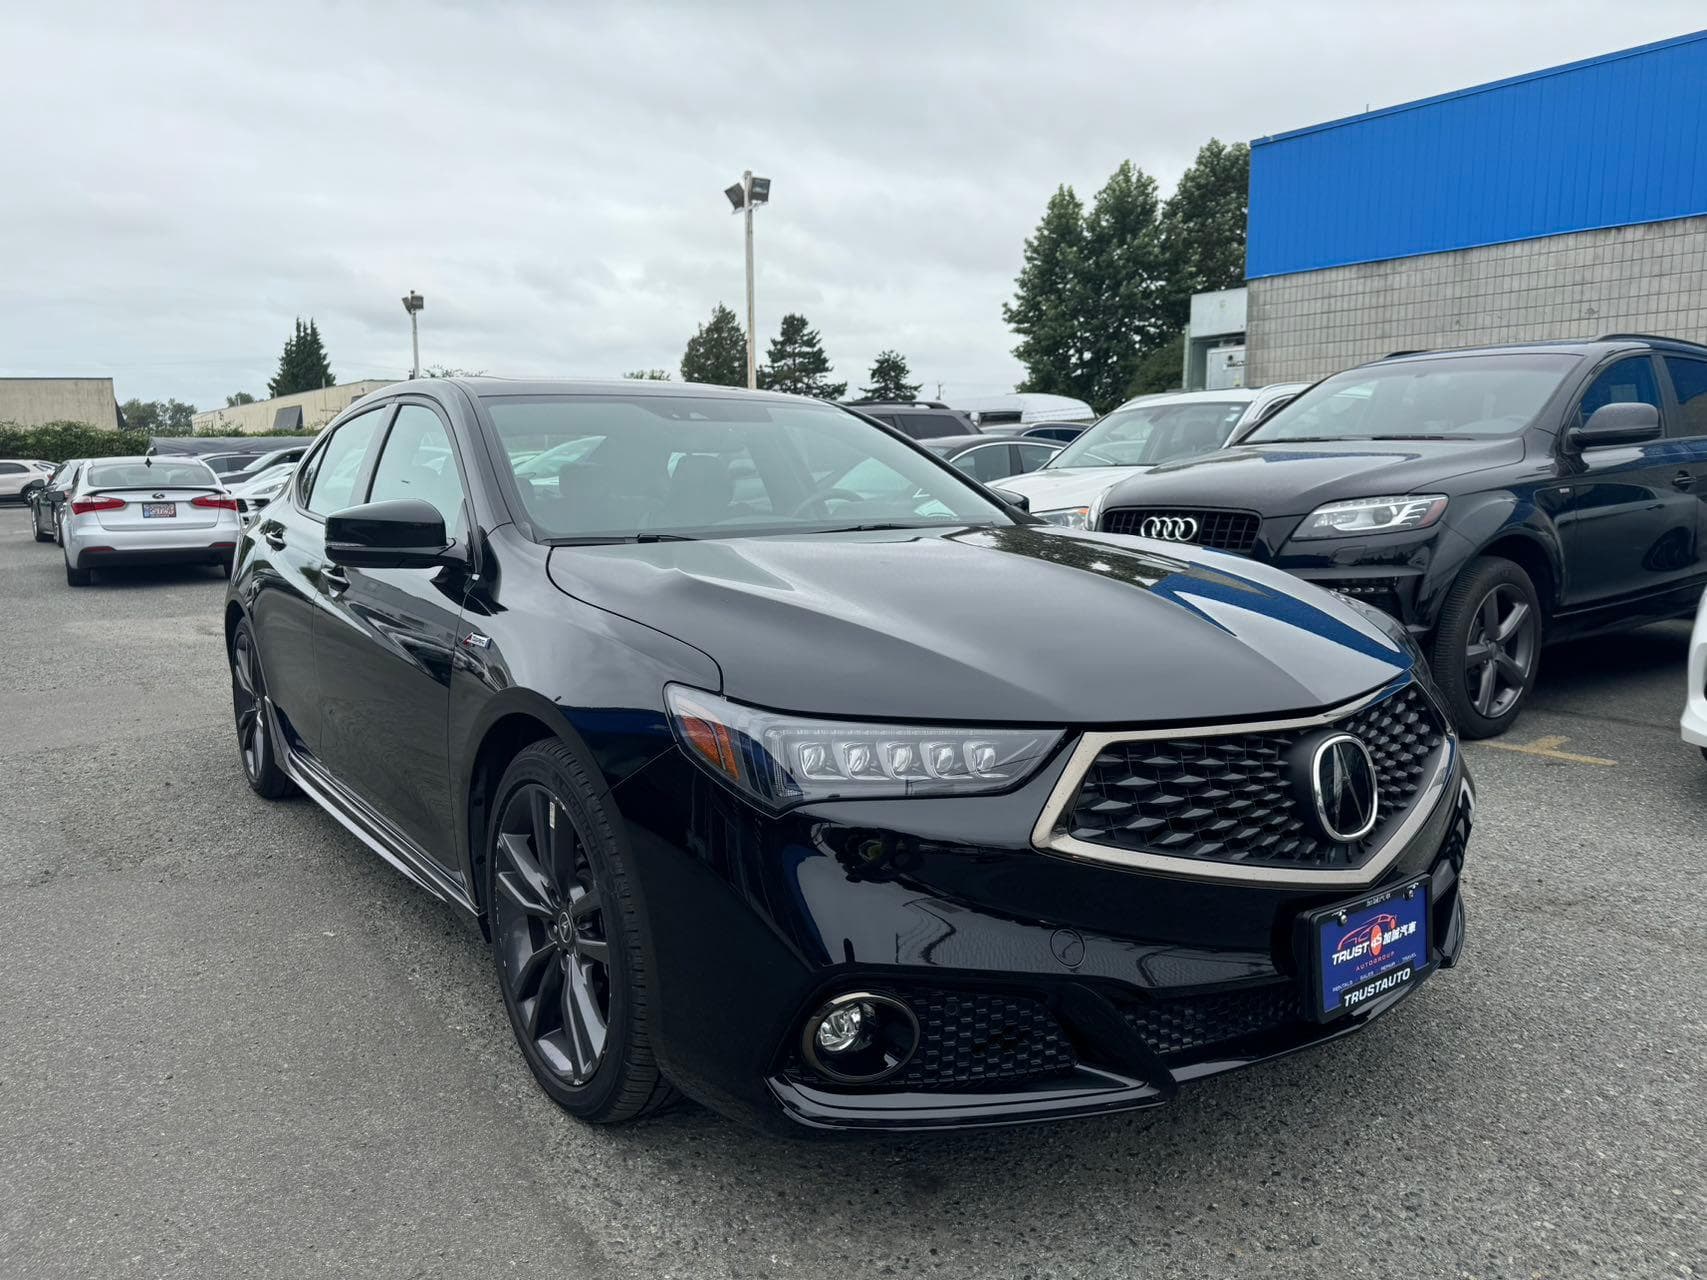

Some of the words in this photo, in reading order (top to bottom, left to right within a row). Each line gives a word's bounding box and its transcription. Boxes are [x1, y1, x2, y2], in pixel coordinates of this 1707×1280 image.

[1332, 942, 1369, 965] TRUST
[1356, 951, 1395, 971] AUTOGROUP
[1344, 968, 1411, 1007] TRUSTAUTO
